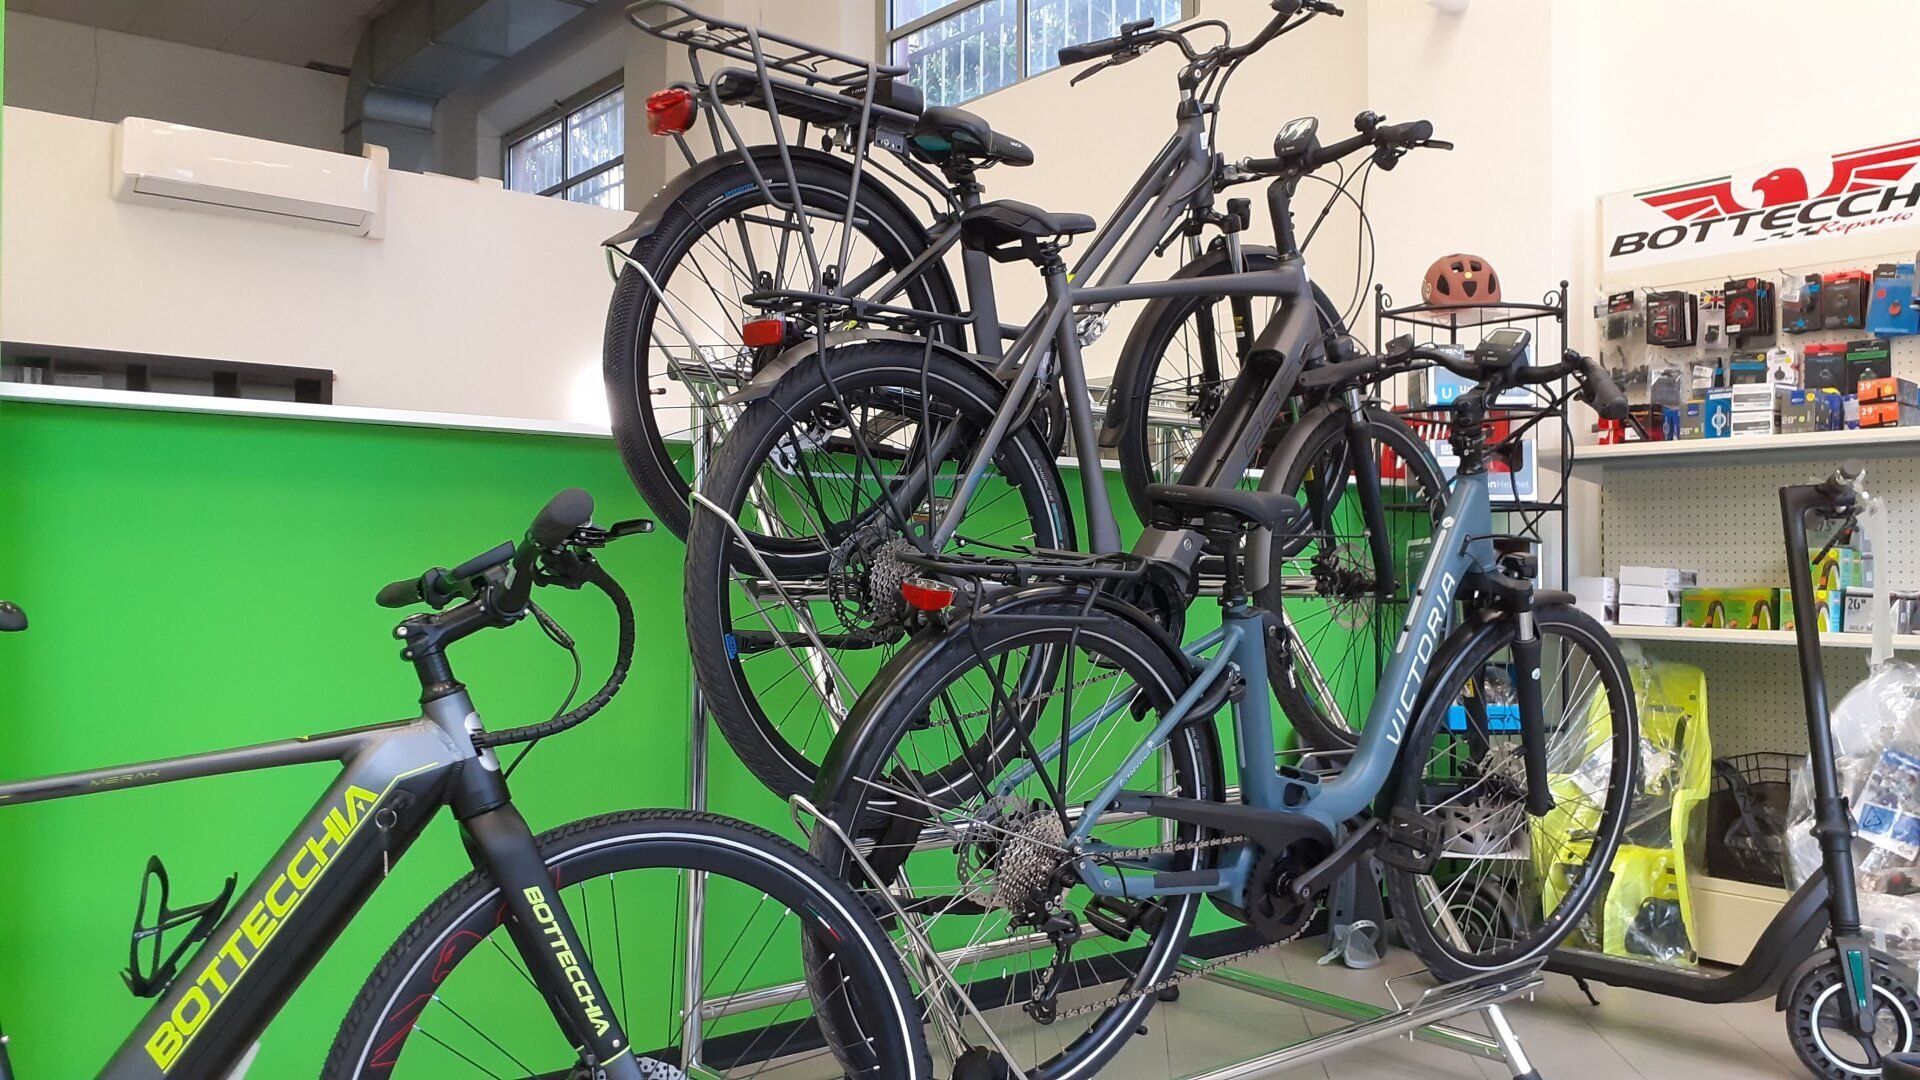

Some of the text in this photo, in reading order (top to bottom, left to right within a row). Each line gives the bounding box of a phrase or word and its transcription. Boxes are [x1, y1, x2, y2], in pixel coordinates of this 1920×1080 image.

[1816, 212, 1913, 235] Reparto
[1386, 571, 1457, 747] VICTORIA
[90, 770, 161, 786] MERAK
[143, 784, 380, 1074] BOTTECCHIA
[522, 885, 611, 1038] BOTTECCHIA
